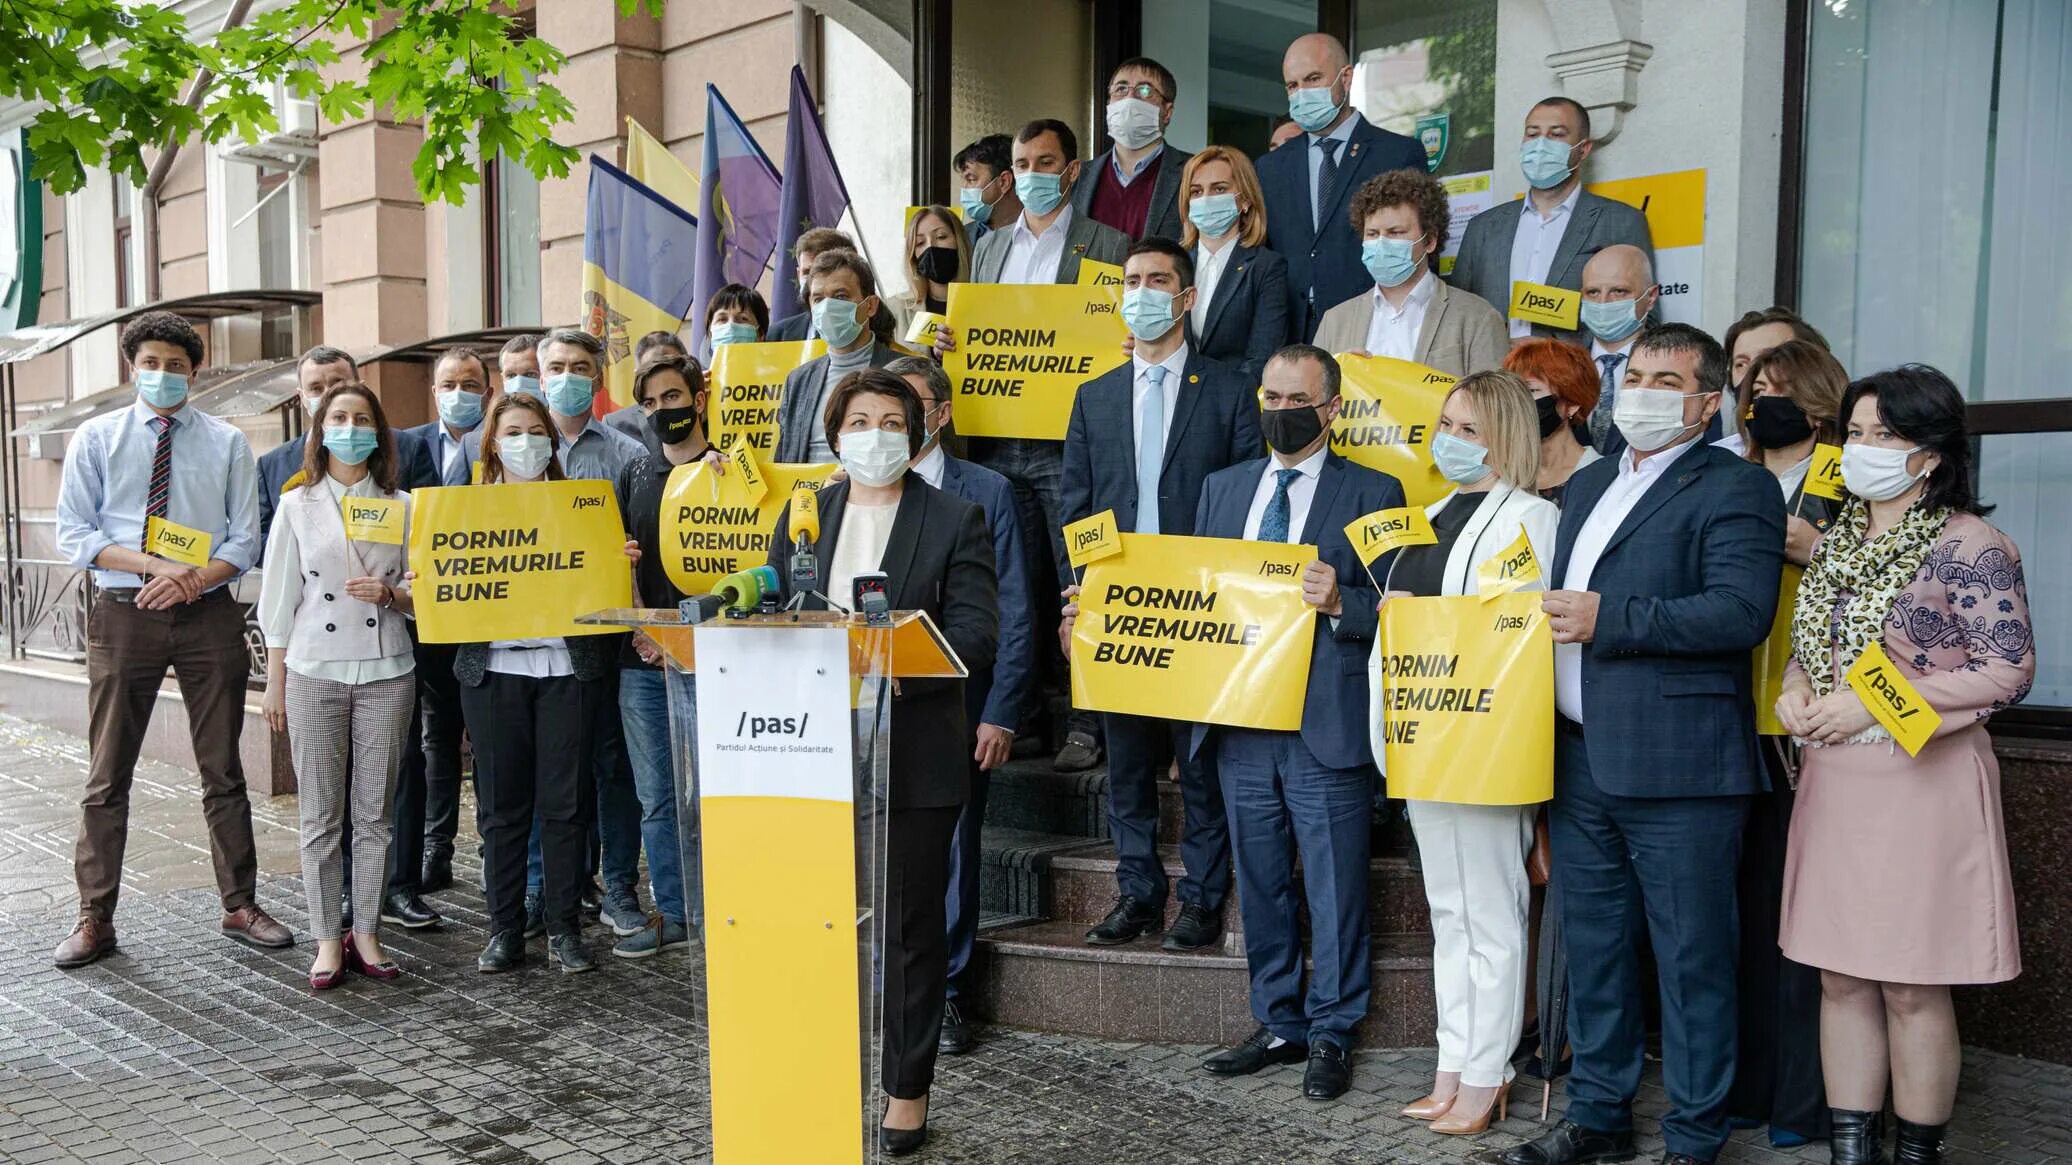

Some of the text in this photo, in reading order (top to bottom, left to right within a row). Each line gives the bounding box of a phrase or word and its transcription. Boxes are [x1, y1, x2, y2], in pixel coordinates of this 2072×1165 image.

[1658, 282, 1689, 296] tate
[1085, 301, 1117, 315] /pas/
[1520, 291, 1565, 312] /pas/
[966, 328, 1056, 347] PORNIM
[965, 353, 1093, 374] VREMURILE
[961, 378, 1024, 397] BUNE
[1423, 373, 1456, 384] /pas
[721, 384, 783, 403] PORNI
[1339, 399, 1381, 419] NIM
[1327, 425, 1426, 447] MURILE
[736, 448, 759, 485] /pas/
[572, 495, 606, 509] /pas/
[349, 505, 389, 522] /pas/
[678, 506, 760, 525] PORNIM
[157, 527, 196, 550] /pas/
[432, 527, 538, 551] PORNIM
[1074, 522, 1104, 550] /pas/
[1364, 515, 1410, 545] /pas/
[679, 532, 771, 552] VREMURI
[434, 551, 585, 577] VREMURILE
[683, 556, 740, 574] BUNE
[1259, 560, 1300, 577] /pas/
[1499, 546, 1532, 580] /pas
[436, 581, 509, 603] BUNE
[1104, 584, 1217, 612] PORNIM
[1103, 614, 1262, 647] VREMURILE
[1494, 614, 1532, 633] /pas/
[1094, 642, 1174, 669] BUNE
[1864, 665, 1920, 719] /pas/
[737, 711, 808, 738] /pas/
[1383, 720, 1420, 745] UNE
[716, 743, 746, 752] Partidul
[788, 745, 834, 754] Solidaritate
